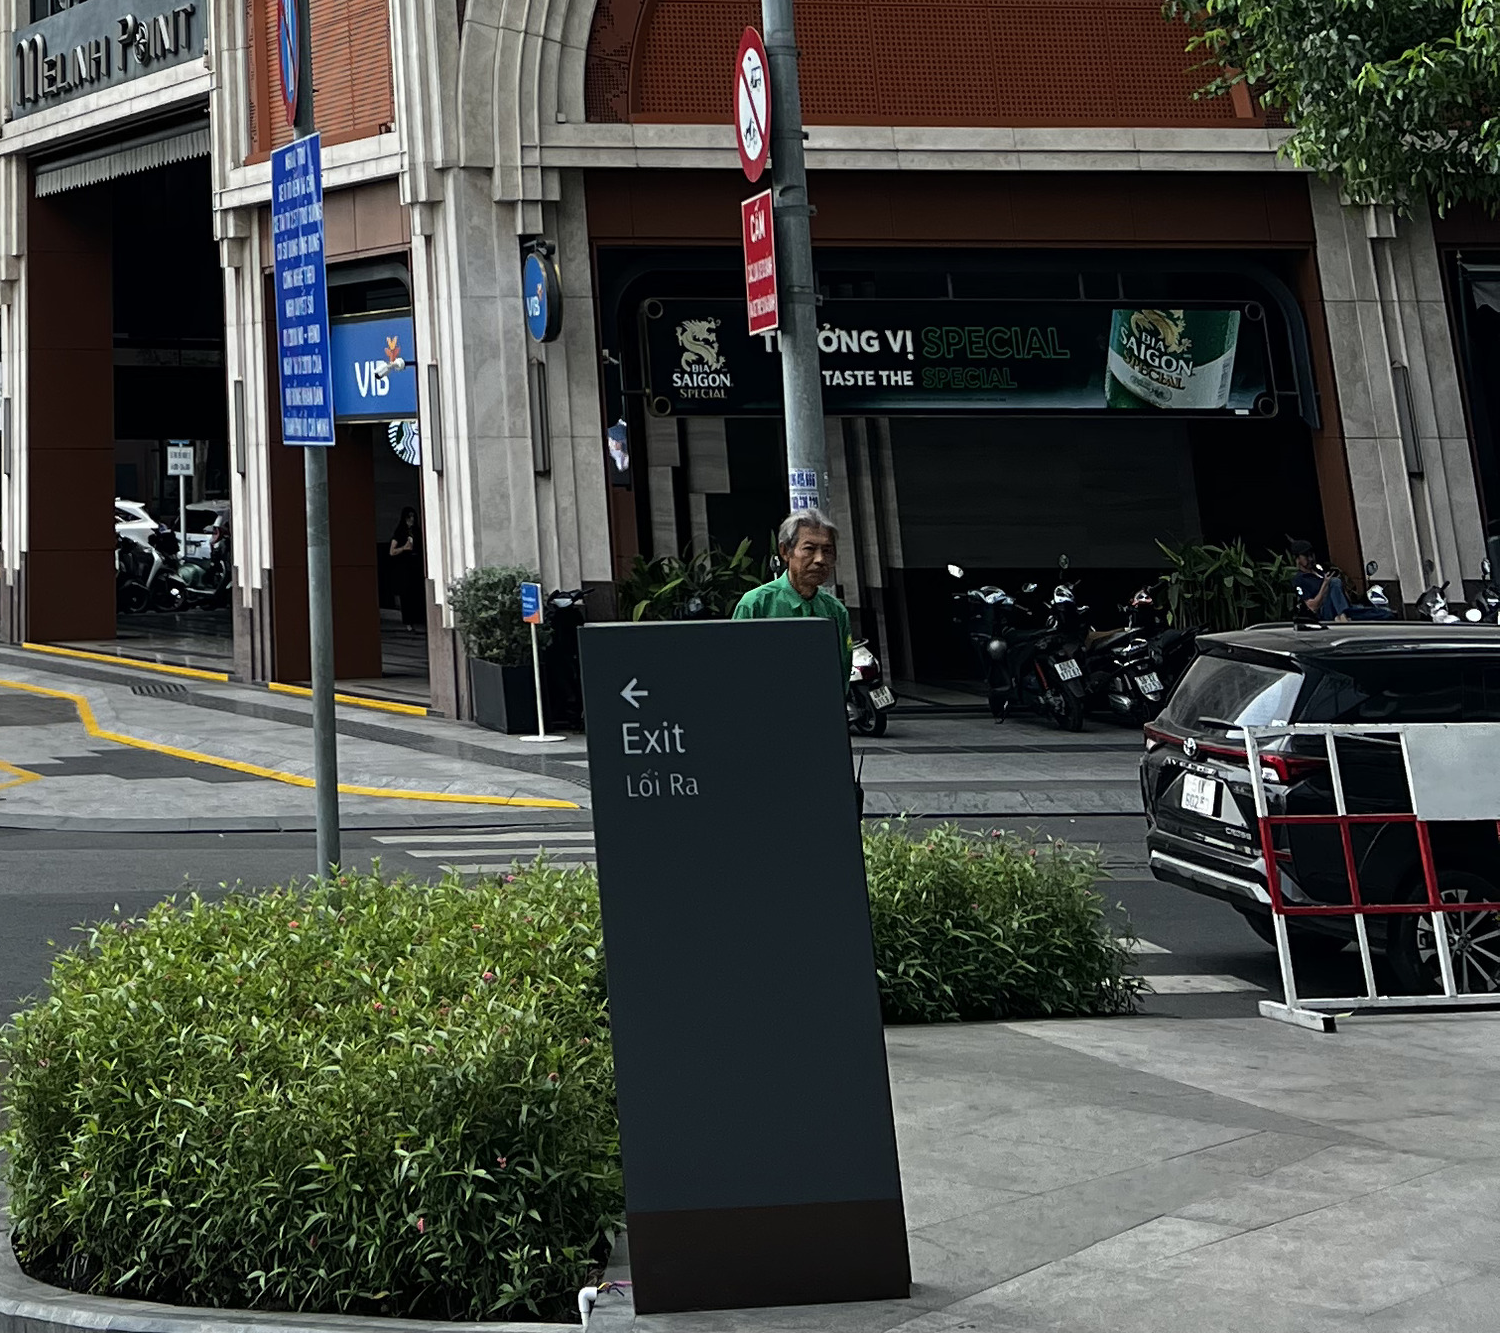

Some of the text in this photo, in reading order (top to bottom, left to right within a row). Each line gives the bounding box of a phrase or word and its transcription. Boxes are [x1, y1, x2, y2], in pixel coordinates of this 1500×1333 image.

[526, 296, 541, 317] VIB
[760, 323, 1070, 360] TỞNG VỊ SPECIAL
[1119, 326, 1193, 377] SAIGON
[1141, 332, 1165, 352] BIA
[354, 360, 390, 398] VIB
[672, 373, 730, 387] SAIGON
[692, 364, 710, 373] BIA
[822, 367, 1018, 388] TASTE THE SPECIAL
[1123, 350, 1186, 390] SPECIAL
[680, 388, 727, 399] SPECIAL
[622, 721, 686, 754] Exit
[626, 768, 699, 797] Lối Ra
